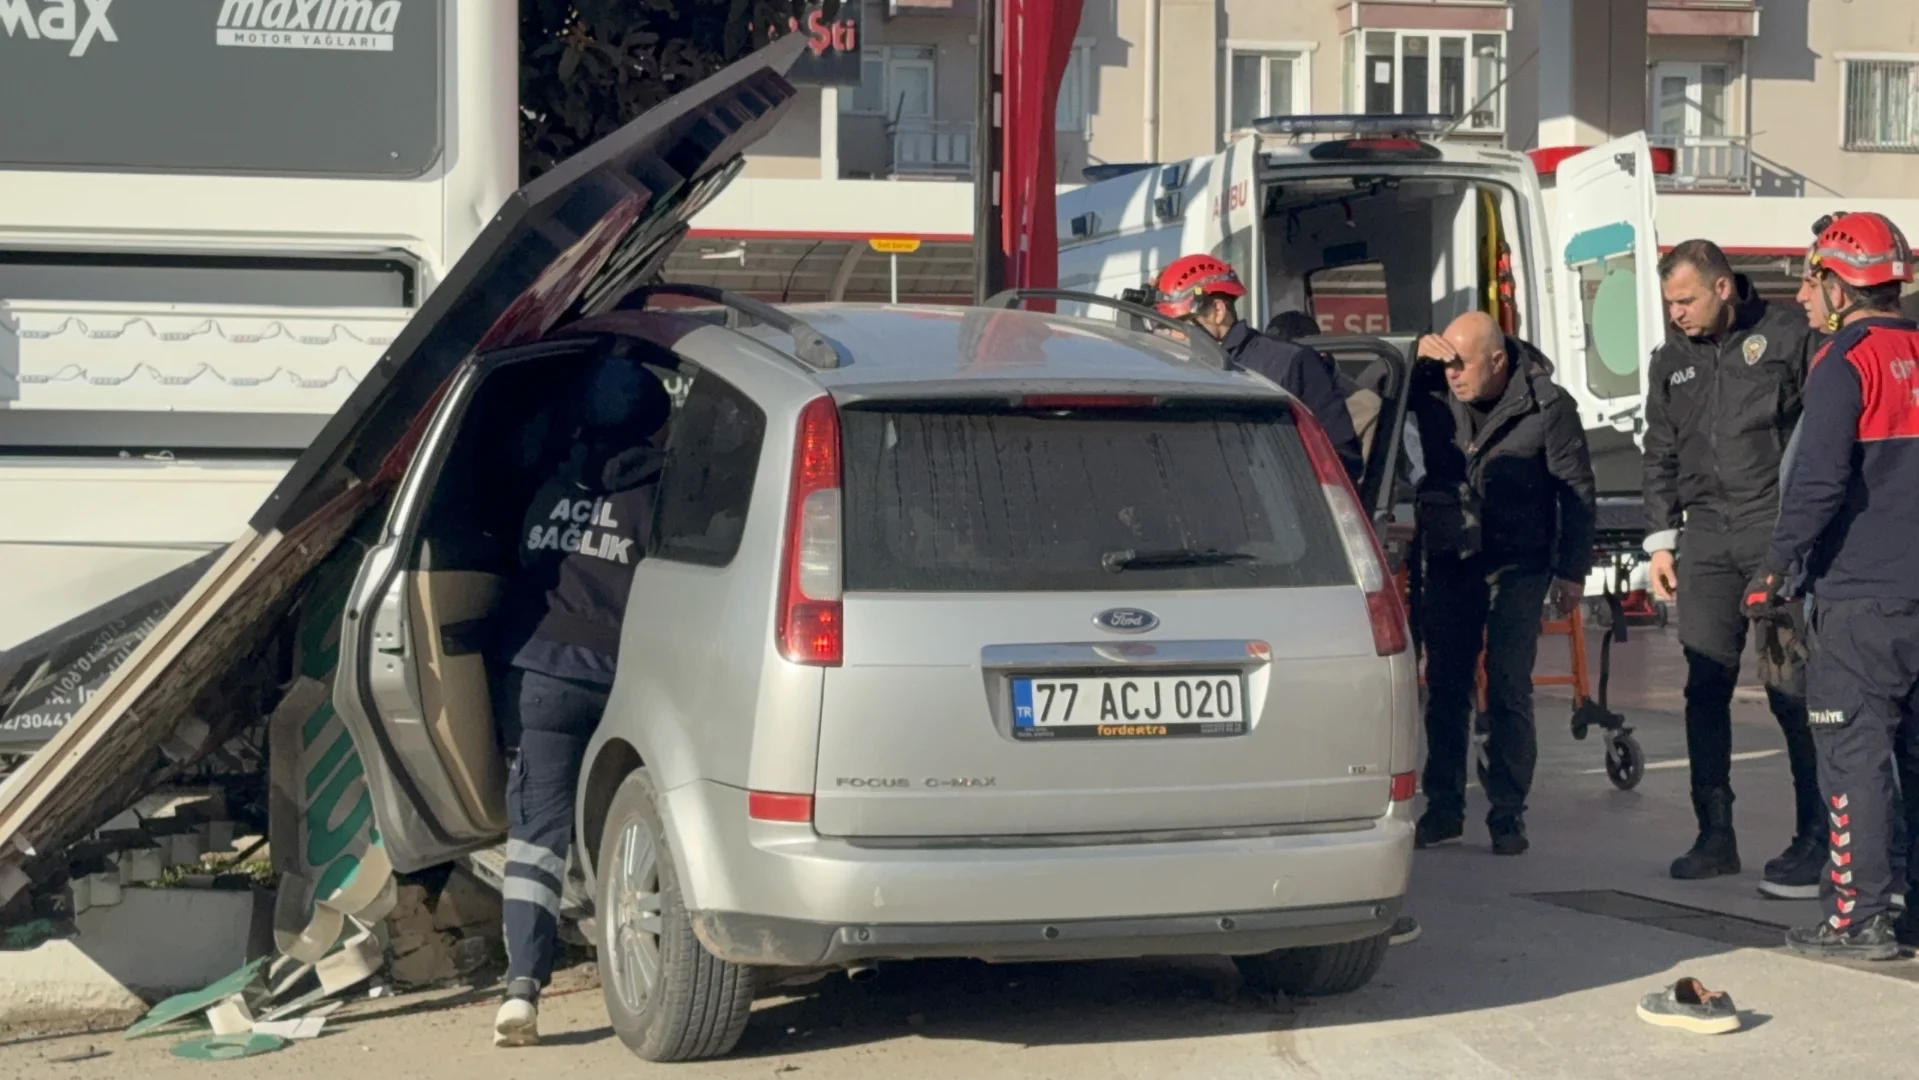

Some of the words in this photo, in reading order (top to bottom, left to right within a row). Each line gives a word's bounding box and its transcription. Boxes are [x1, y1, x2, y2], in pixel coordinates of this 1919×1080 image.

[233, 32, 292, 44] MOTOR
[302, 33, 377, 47] YAĞLARI
[527, 523, 634, 564] SAĞLIK
[1110, 610, 1144, 627] Ford
[1016, 706, 1033, 718] TR
[1036, 683, 1079, 723] 77
[1100, 681, 1162, 721] ACJ
[1174, 680, 1234, 719] 020
[836, 776, 911, 789] FOCUS
[924, 776, 997, 789] C-MAX
